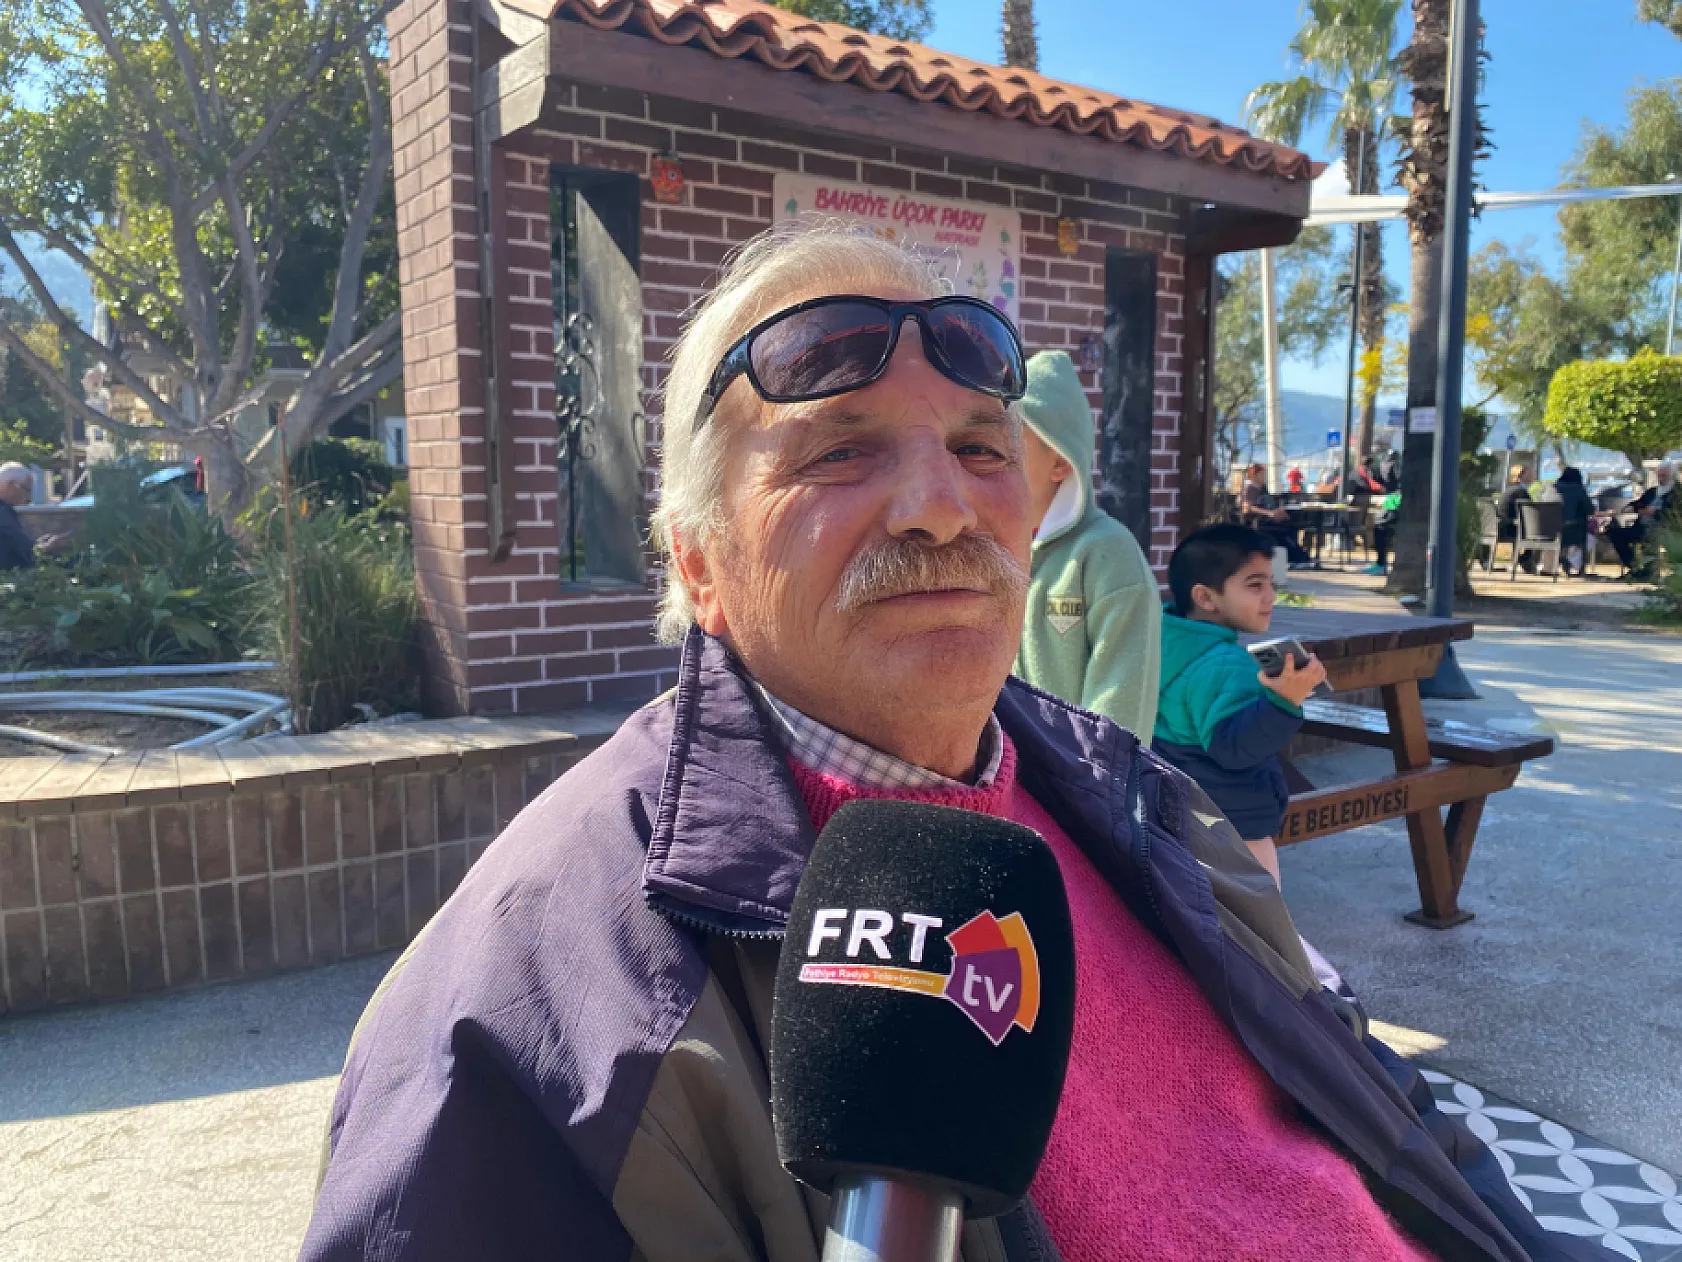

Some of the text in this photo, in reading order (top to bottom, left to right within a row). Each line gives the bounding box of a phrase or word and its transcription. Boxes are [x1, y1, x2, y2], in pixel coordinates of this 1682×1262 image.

[815, 187, 987, 232] BAHRİYE ÜÇOK PARKI
[1306, 784, 1409, 833] BELEDİYESİ
[807, 908, 942, 963] FRT
[804, 967, 836, 979] Fethiye
[839, 969, 870, 980] Radyo
[963, 964, 1014, 1013] tv
